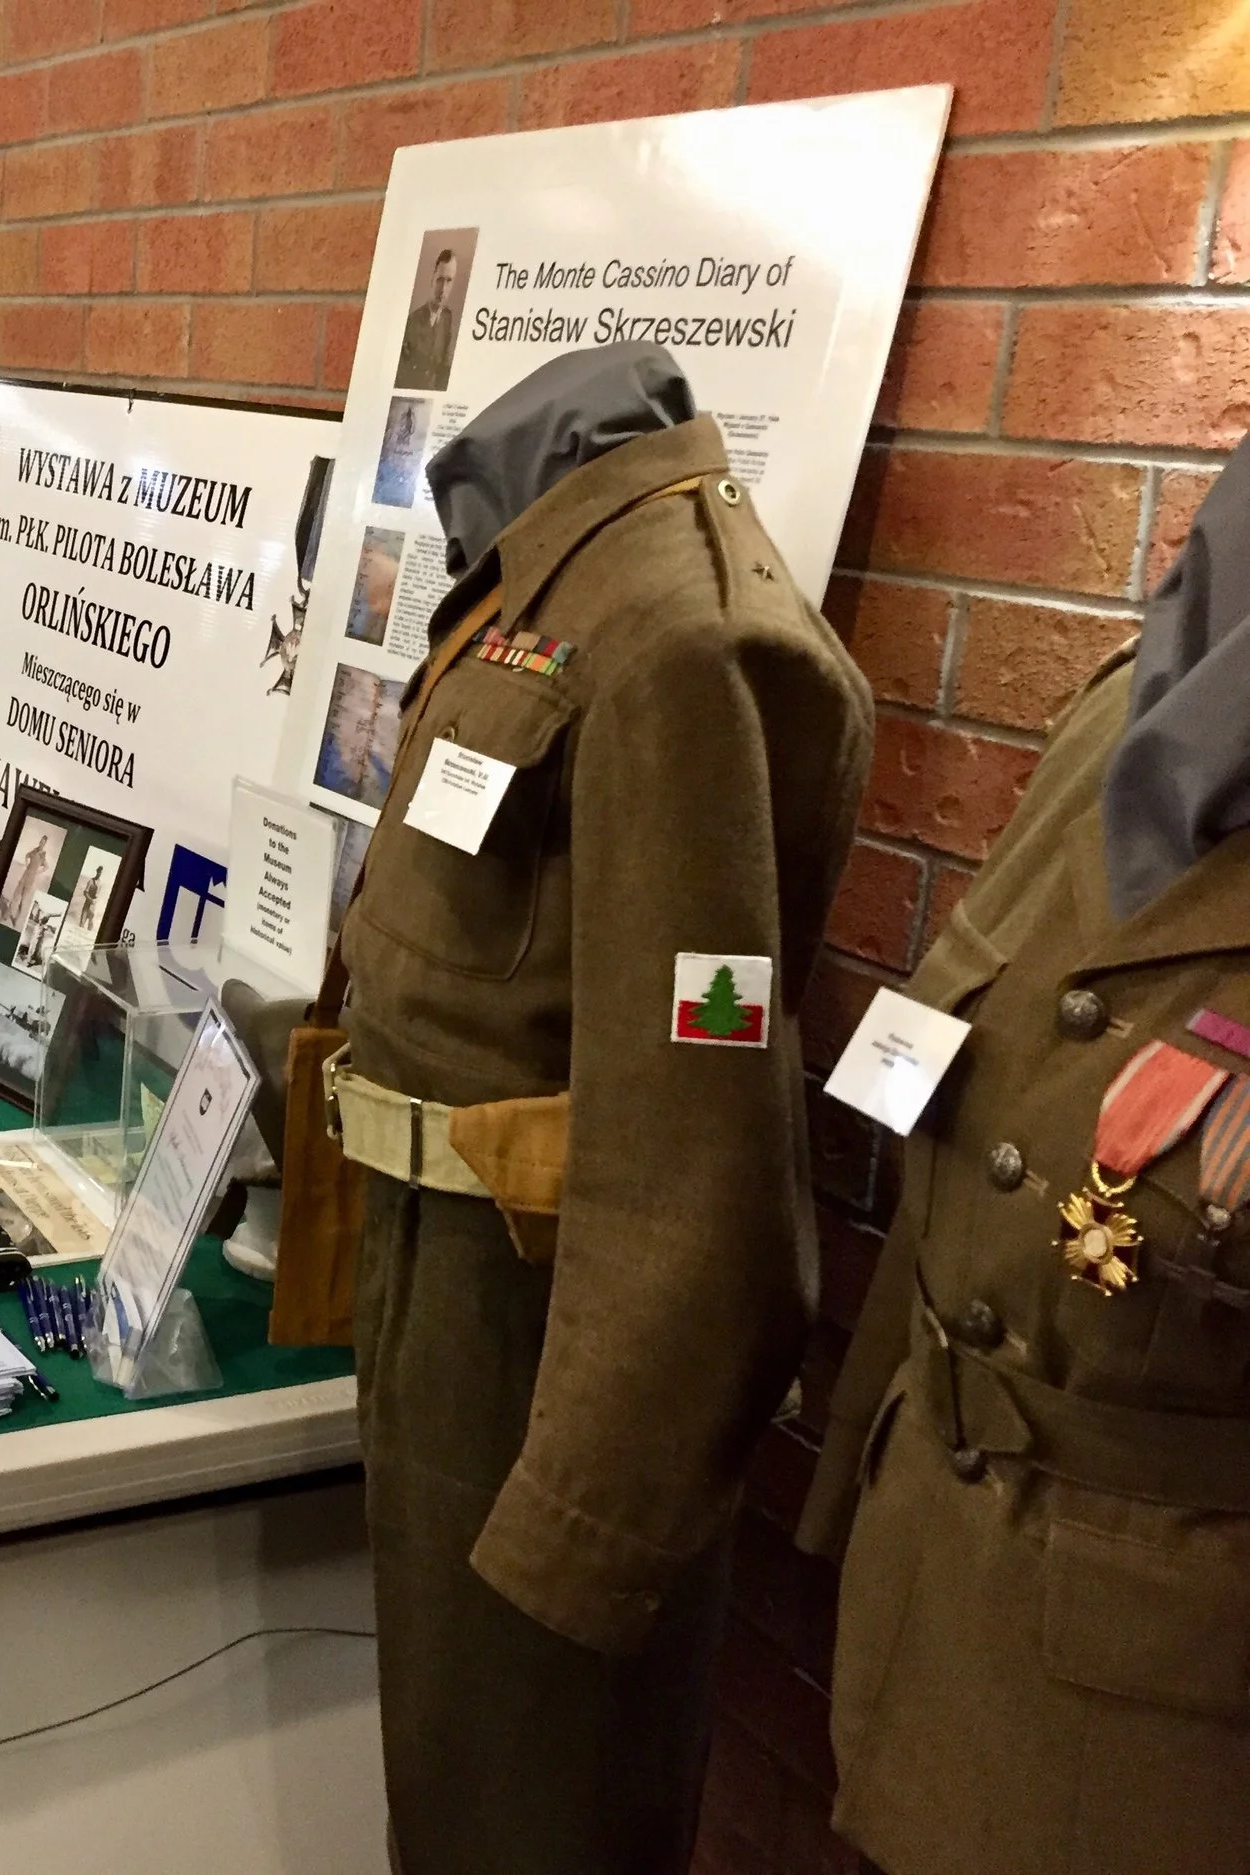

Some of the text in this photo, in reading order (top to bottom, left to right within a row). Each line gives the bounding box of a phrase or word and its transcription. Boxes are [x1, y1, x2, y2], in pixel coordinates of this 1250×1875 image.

[496, 256, 795, 295] The Monte Cassino Diary of
[472, 307, 797, 348] Stanisław Skrzeszewski
[17, 447, 253, 529] WYSTAWA z MUZEUM
[16, 515, 49, 552] PŁK.
[52, 524, 116, 572] PILOTA
[118, 541, 256, 611] BOLESŁAWA
[22, 582, 171, 669] ORLIŃSKIEGO
[21, 652, 141, 725] Mieszczącego się w
[6, 696, 135, 789] DOMU SENIORA
[263, 817, 297, 840] Donations
[269, 838, 289, 855] to the
[263, 852, 292, 874] Museum
[264, 871, 289, 891] Always
[258, 886, 291, 910] Accepted
